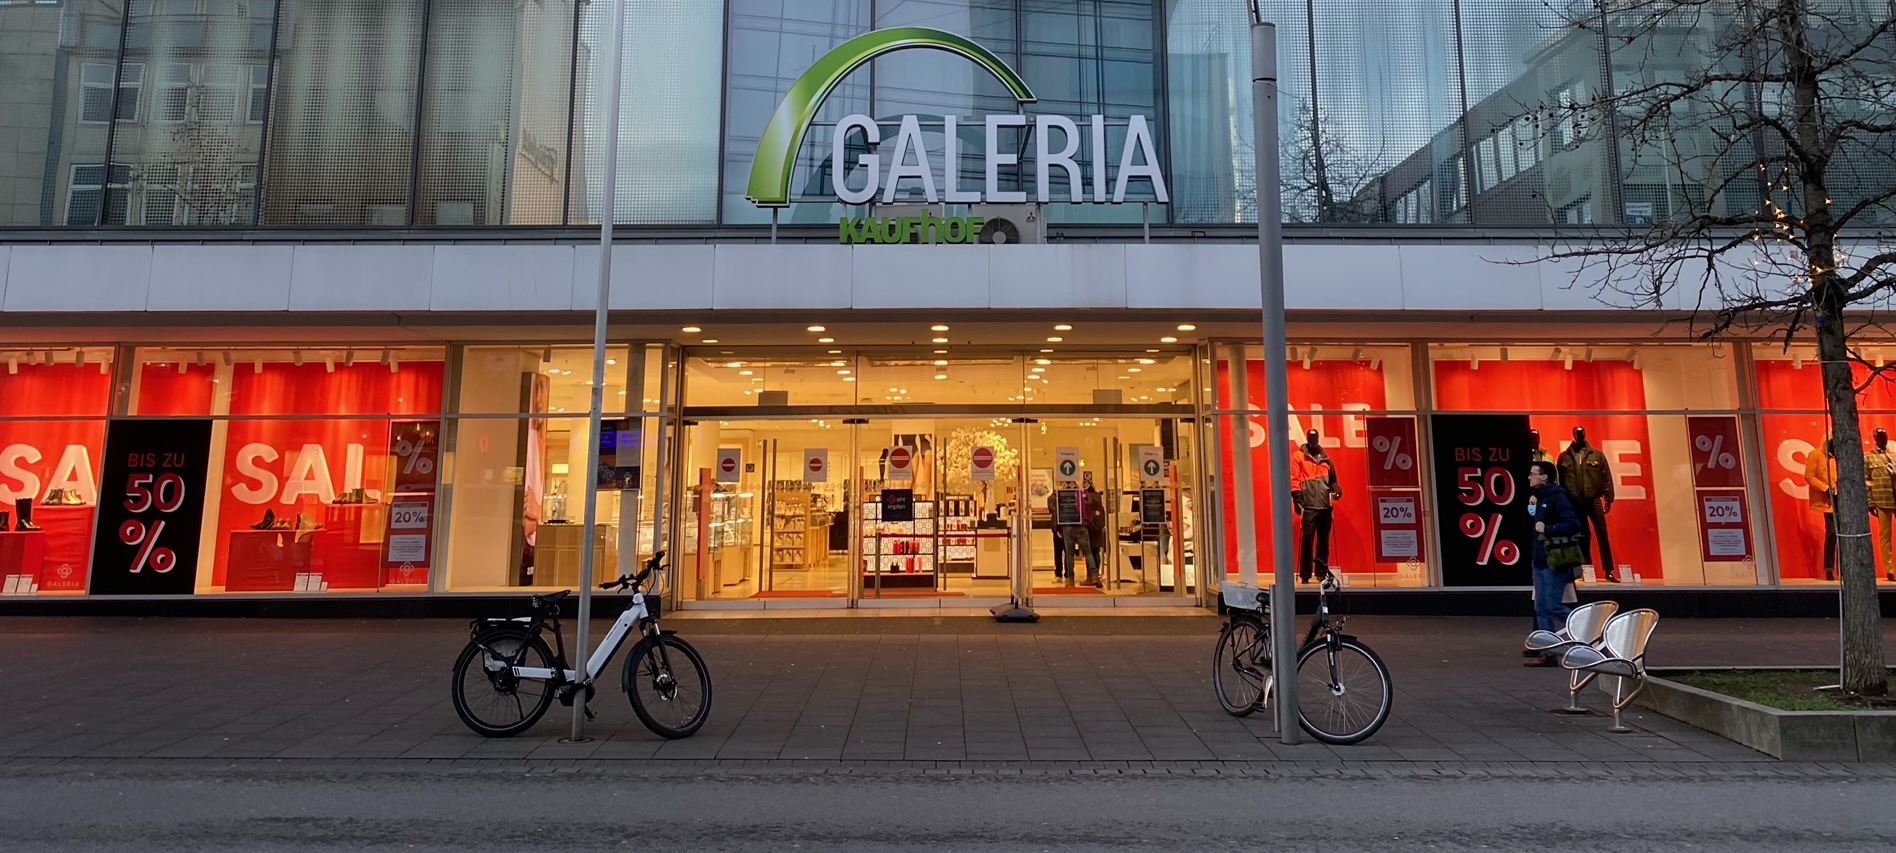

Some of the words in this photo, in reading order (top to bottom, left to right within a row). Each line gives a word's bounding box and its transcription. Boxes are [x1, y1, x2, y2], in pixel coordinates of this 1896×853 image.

[832, 114, 1169, 204] GALERIA
[128, 453, 155, 467] BIS
[162, 453, 185, 467] ZU
[1455, 448, 1482, 461] BIS
[1489, 447, 1510, 461] ZU
[123, 473, 186, 513] 50
[1458, 467, 1515, 506] 50
[394, 511, 425, 523] 20%
[1383, 507, 1412, 518] 20%
[1708, 506, 1738, 517] 20%
[119, 519, 176, 573] %
[1459, 513, 1520, 565] %
